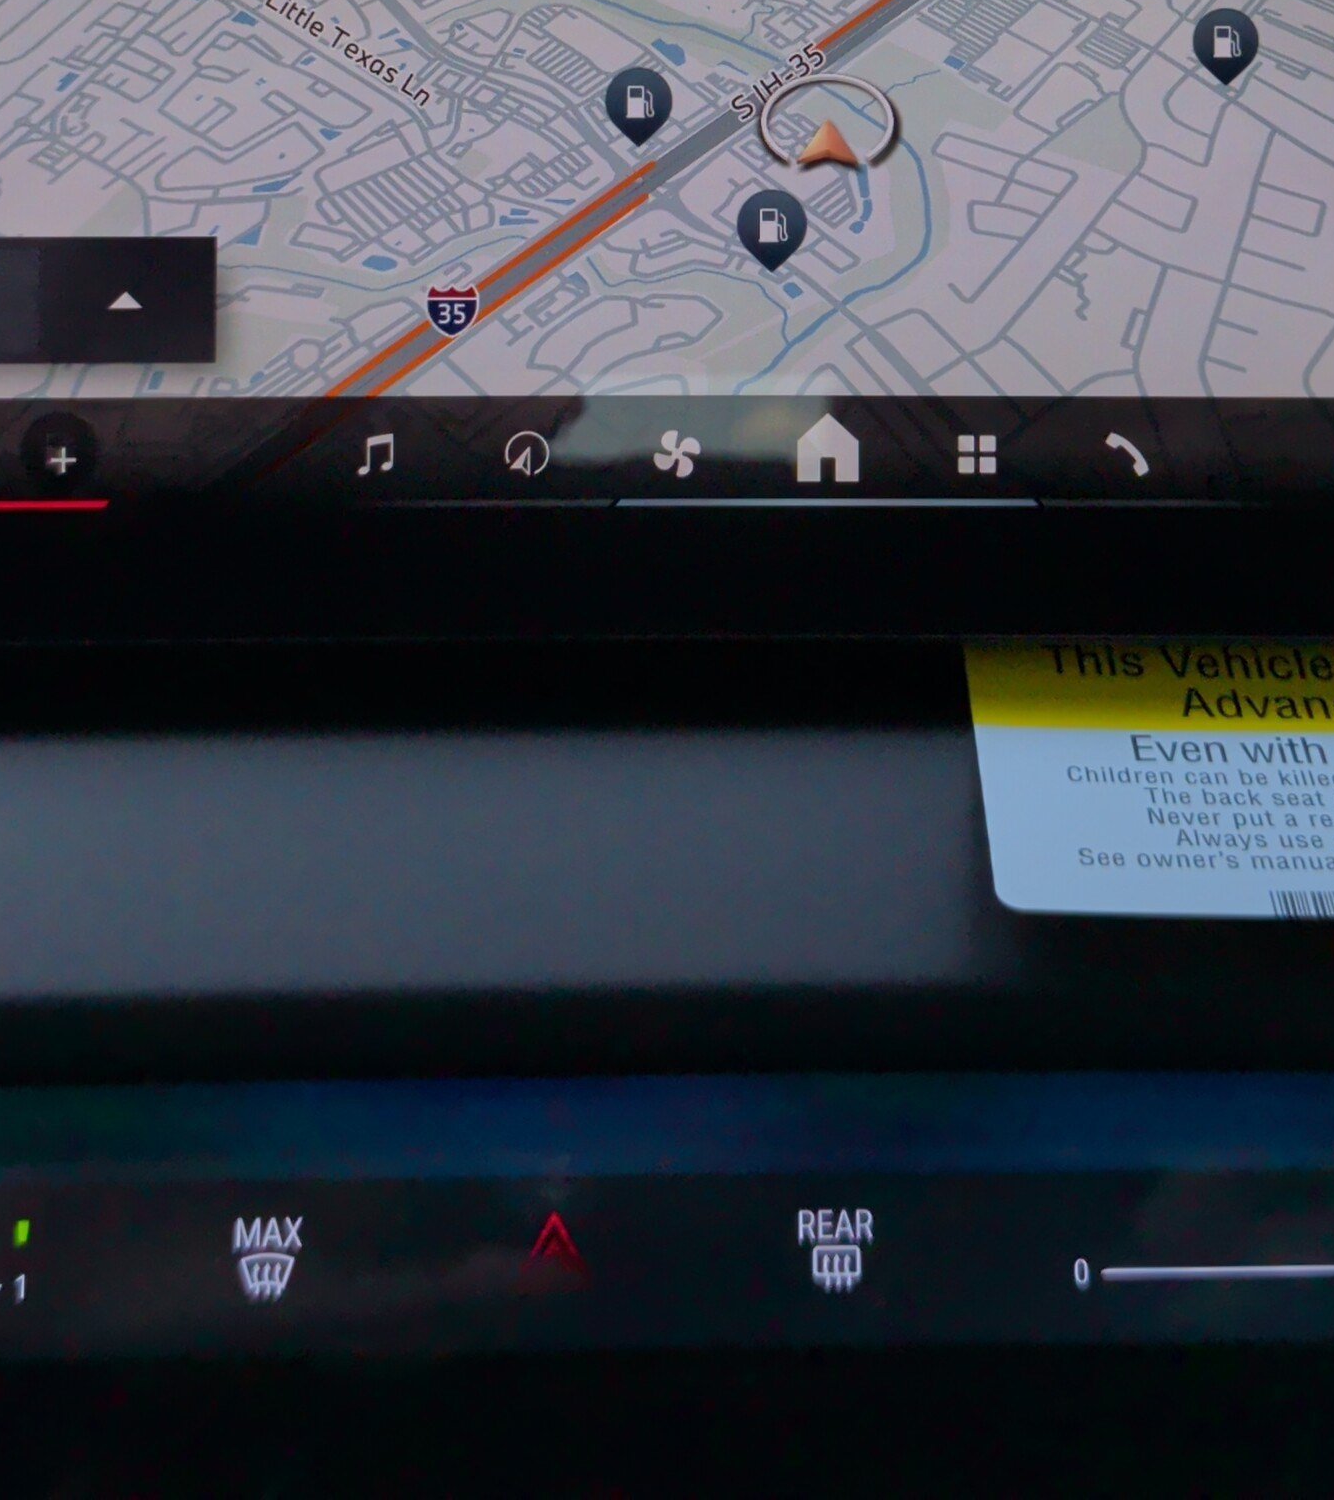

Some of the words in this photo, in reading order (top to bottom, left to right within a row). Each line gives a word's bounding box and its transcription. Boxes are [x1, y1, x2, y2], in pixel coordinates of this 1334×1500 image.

[330, 26, 399, 88] Texas
[399, 72, 432, 108] Ln
[730, 94, 754, 121] S
[755, 44, 825, 101] IH-35
[438, 303, 467, 325] 35
[1047, 645, 1145, 678] This
[1161, 646, 1334, 681] Vehicle
[1131, 734, 1229, 765] Even
[1245, 736, 1328, 766] with
[1067, 765, 1174, 786] Children
[1184, 770, 1230, 787] can
[1240, 768, 1268, 787] be
[1143, 786, 1192, 806] The
[1203, 788, 1263, 807] back
[1272, 790, 1326, 808] seat
[1147, 807, 1222, 828] Never
[1233, 812, 1275, 832] put
[1284, 814, 1300, 829] a
[1176, 830, 1268, 852] Always
[1278, 834, 1325, 850] use
[1078, 847, 1126, 868] See
[1137, 851, 1240, 871] owner's
[232, 1216, 304, 1251] MAX
[797, 1208, 875, 1245] REAR
[1073, 1257, 1090, 1290] 0
